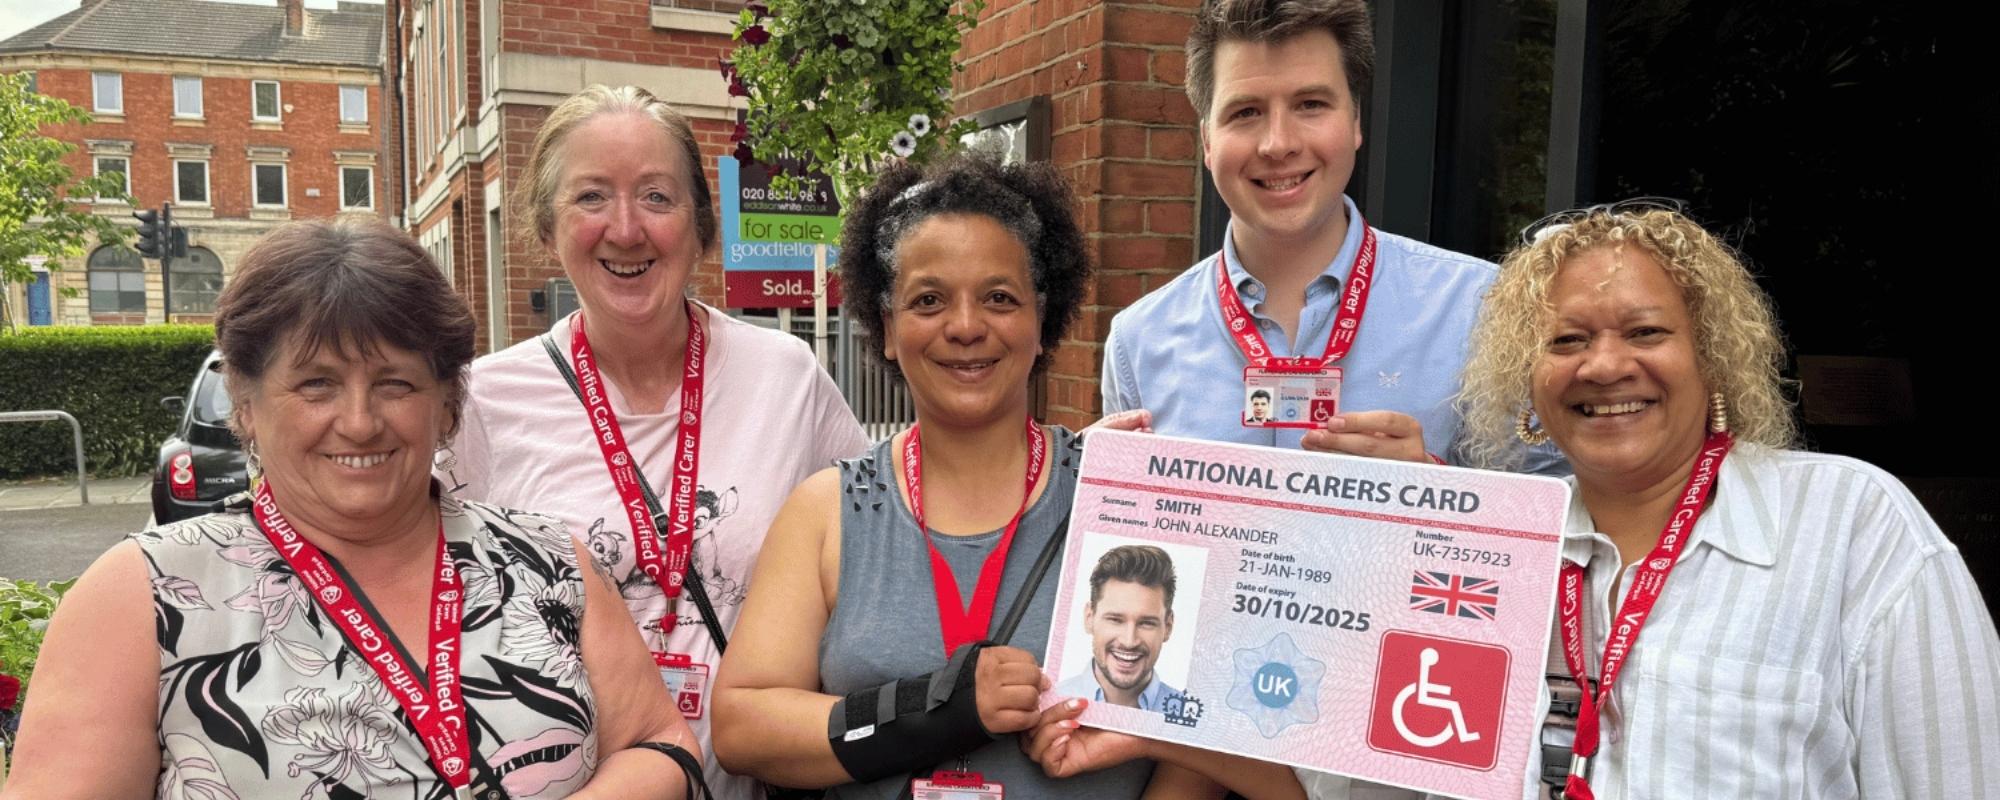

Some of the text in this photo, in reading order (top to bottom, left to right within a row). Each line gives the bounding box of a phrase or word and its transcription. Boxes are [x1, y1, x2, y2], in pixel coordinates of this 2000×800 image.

[742, 187, 765, 200] 020
[799, 190, 828, 202] 989
[745, 218, 823, 239] for sale
[762, 278, 802, 296] Sold
[1344, 277, 1366, 314] Carer
[687, 321, 701, 378] Verified
[576, 345, 604, 406] Verified
[593, 405, 617, 446] Carer
[674, 432, 695, 535] Verified Carer
[1148, 455, 1278, 490] NATIONAL
[1286, 472, 1392, 503] CARERS
[1399, 484, 1480, 514] CARD
[1662, 447, 1724, 552] Verified Carer
[1101, 495, 1137, 508] Surname
[1155, 499, 1202, 516] SMITH
[256, 492, 304, 558] Verified
[629, 498, 658, 560] Verified
[1098, 514, 1148, 528] Given names
[1152, 516, 1278, 545] JOHN ALEXANDER
[1415, 530, 1455, 542] Number
[1238, 559, 1332, 584] 21-JAN-1989
[1241, 548, 1295, 563] Date of birth
[1413, 542, 1512, 568] UK-7357923
[1236, 581, 1296, 599] Date of expiry
[1563, 574, 1577, 616] Carer
[1232, 594, 1371, 632] 30/10/2025
[340, 608, 430, 720] Verified Carer
[1603, 611, 1644, 686] Verified
[435, 637, 459, 712] Verified
[1257, 673, 1293, 697] UK
